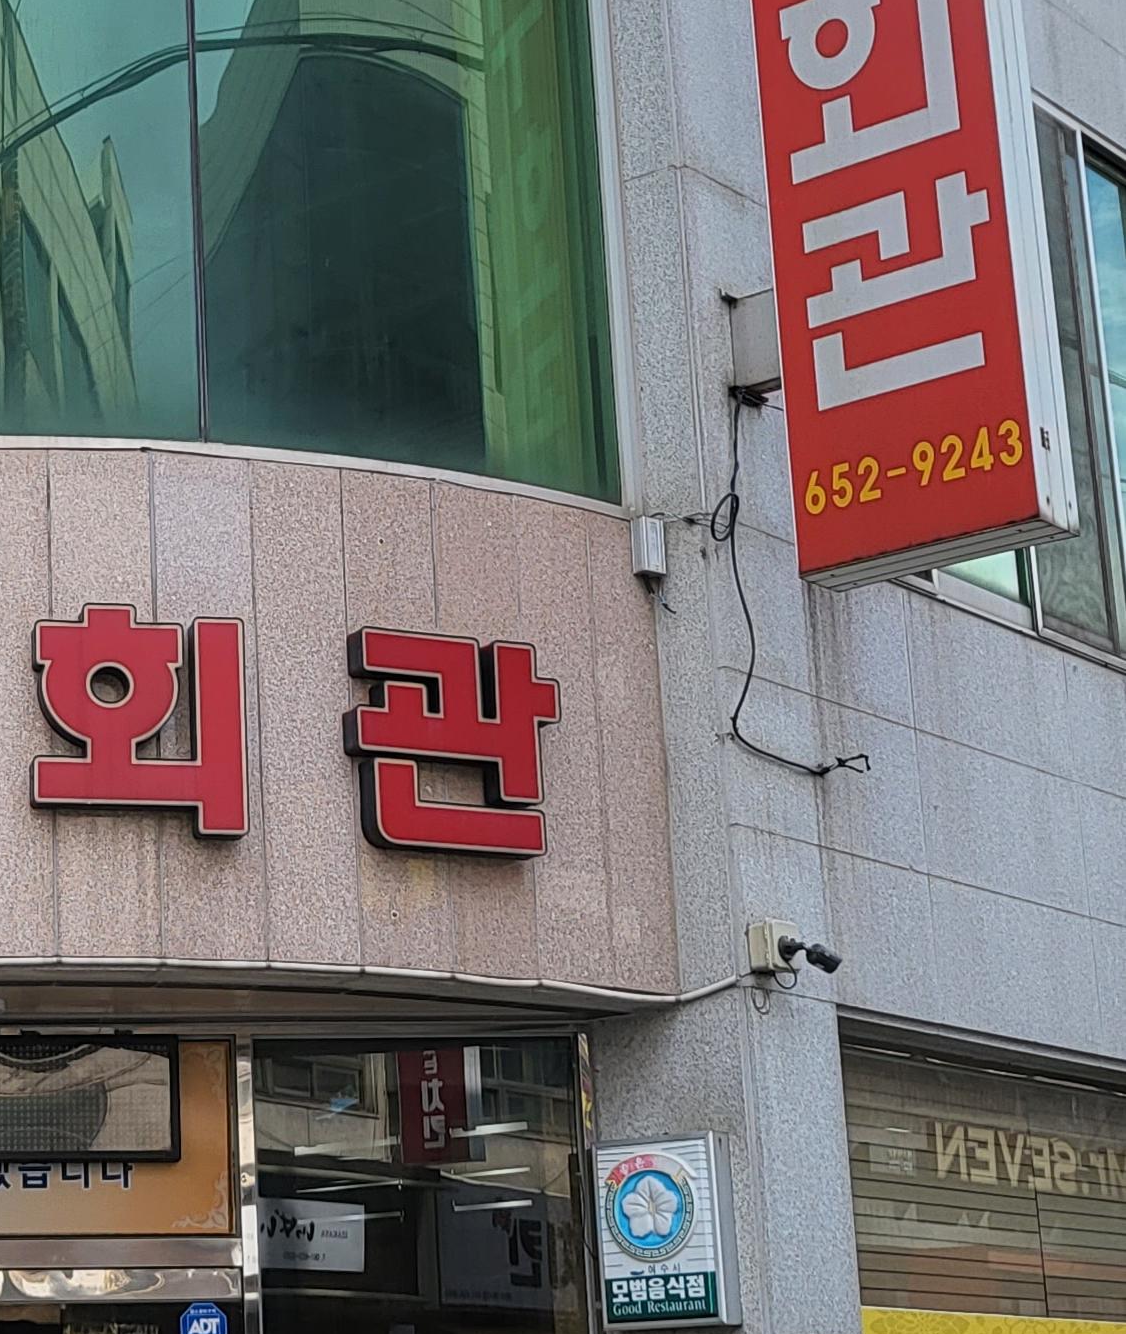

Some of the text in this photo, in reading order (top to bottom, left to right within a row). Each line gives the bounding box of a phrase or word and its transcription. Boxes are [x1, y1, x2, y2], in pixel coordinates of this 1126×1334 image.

[804, 420, 1023, 516] 652-9243
[612, 1274, 706, 1303] 모범음식점
[613, 1298, 707, 1317] Good Restaurant
